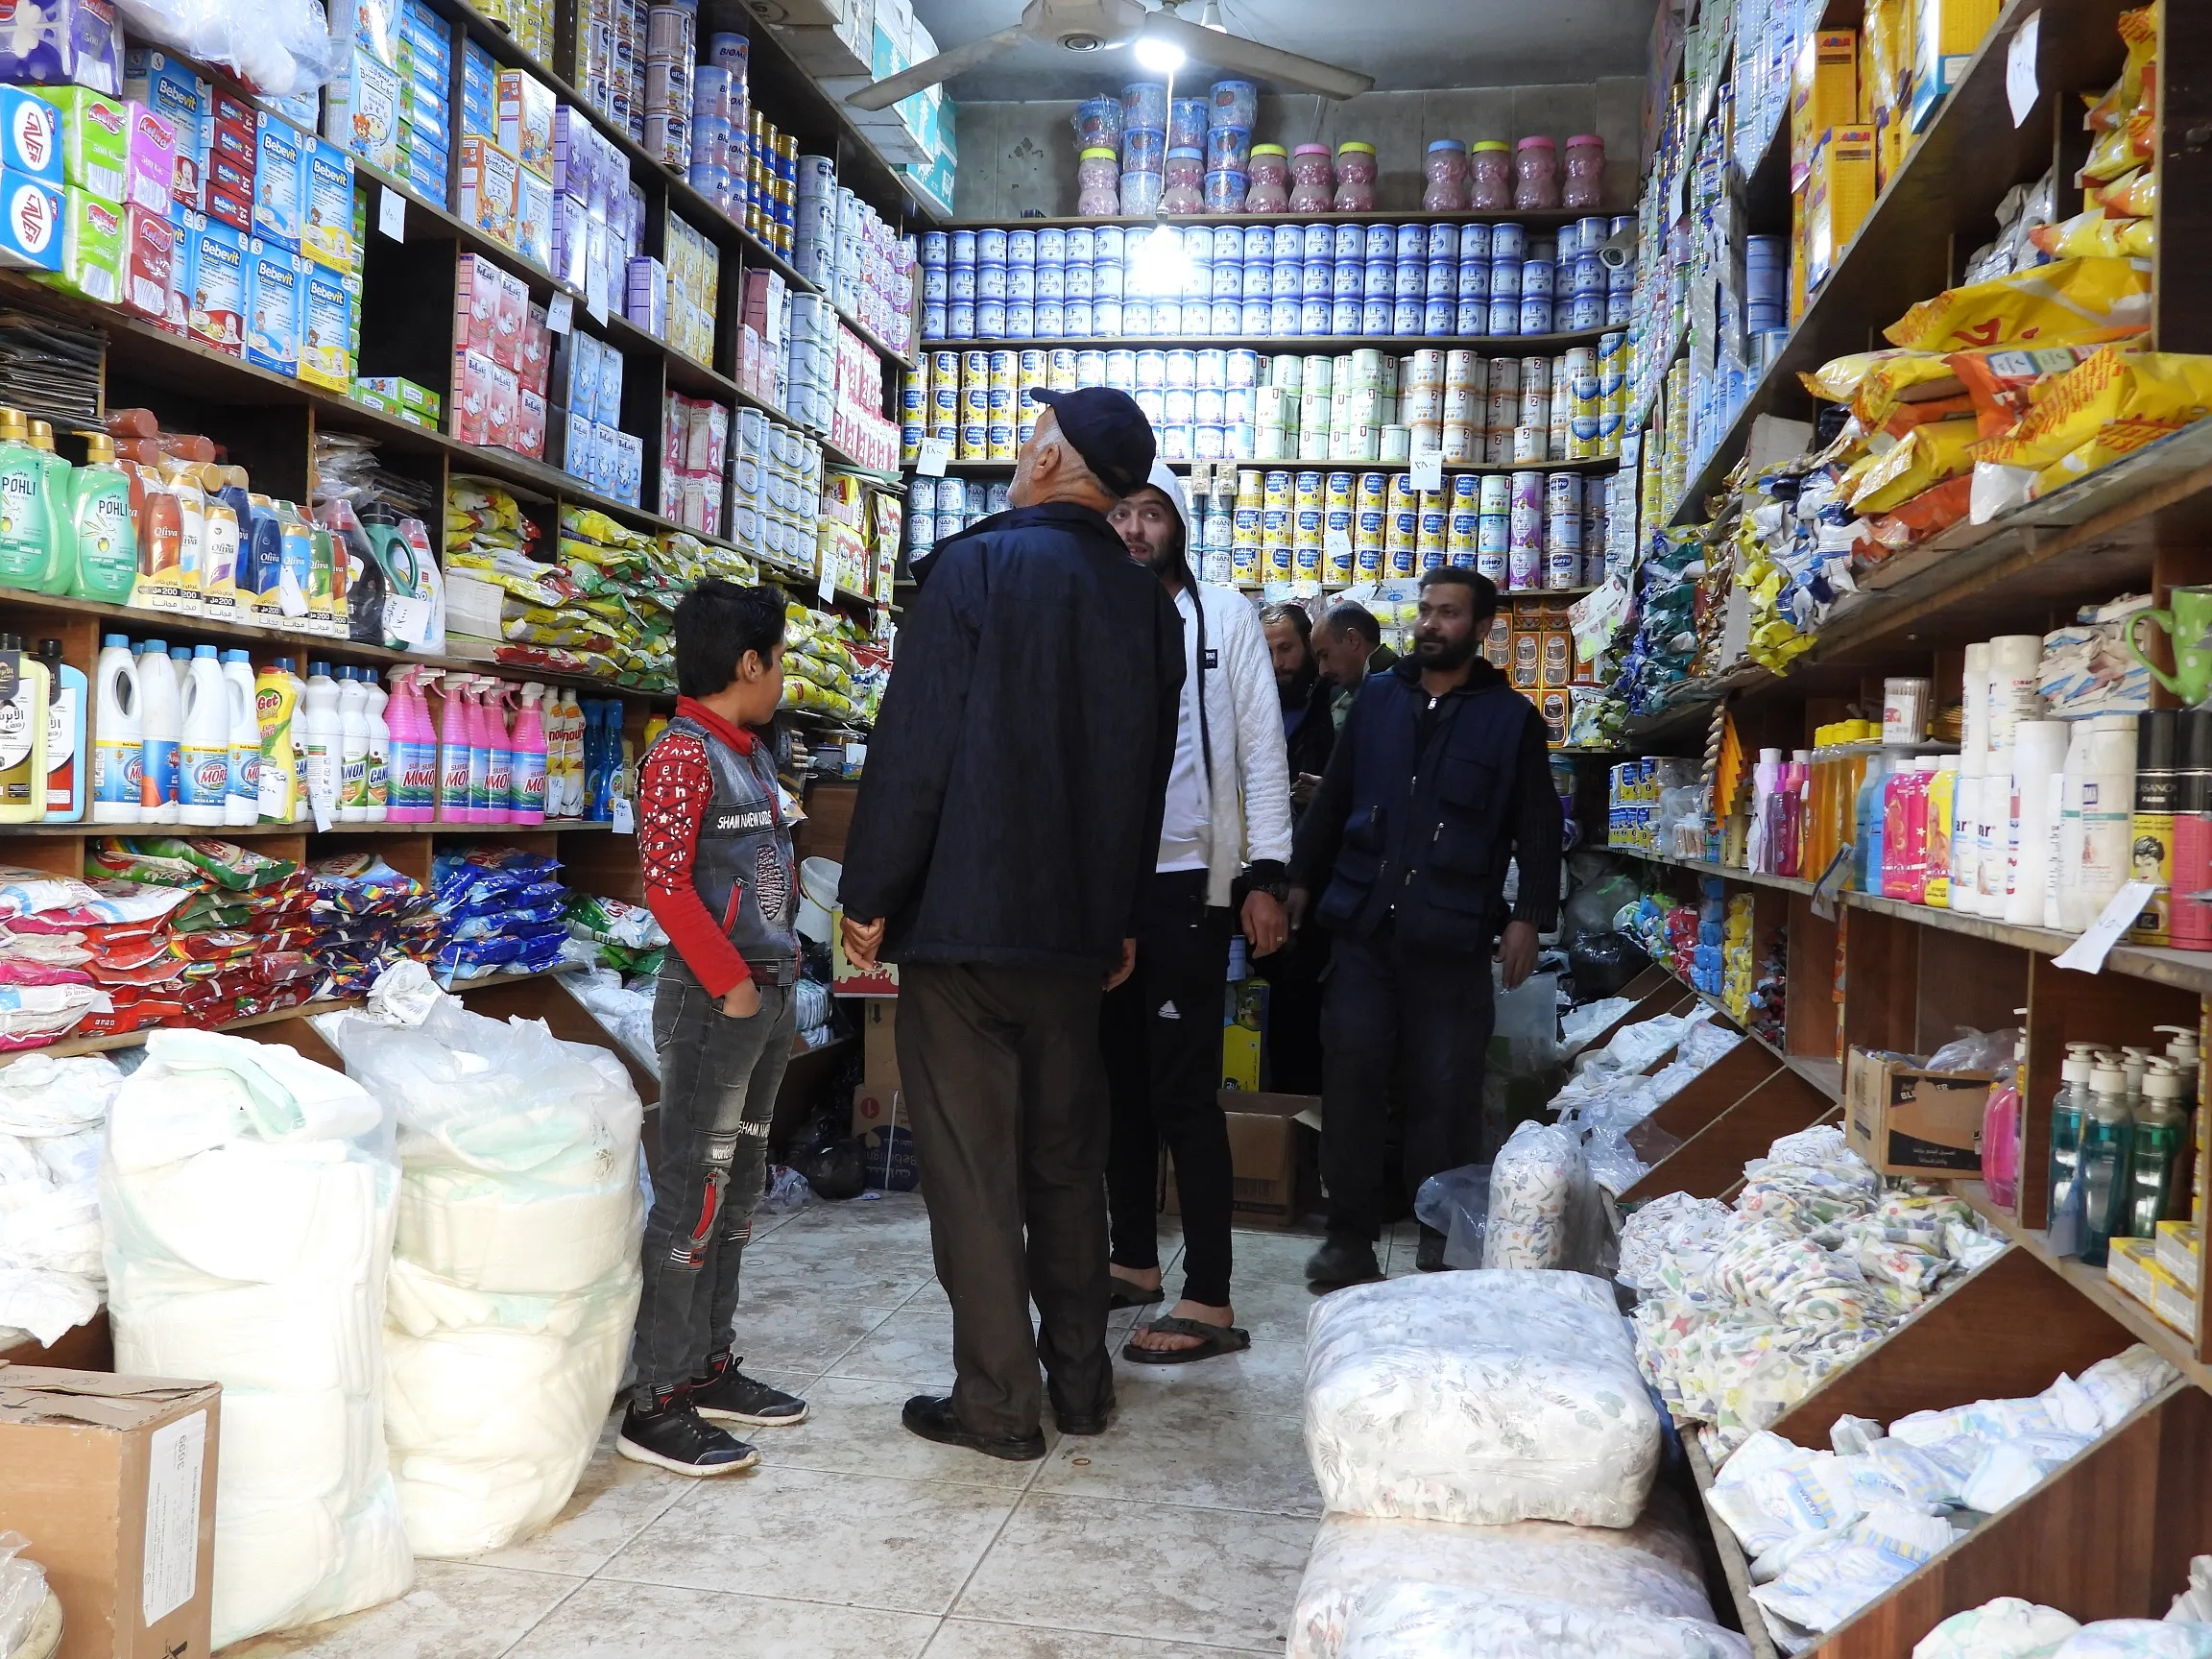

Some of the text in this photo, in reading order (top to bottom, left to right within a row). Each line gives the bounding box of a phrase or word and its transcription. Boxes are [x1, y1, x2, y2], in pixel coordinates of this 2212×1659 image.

[160, 80, 197, 110] Bebevit
[220, 101, 242, 119] Bebevit
[221, 133, 243, 151] Bebevit
[265, 135, 296, 162] Bebevit
[218, 165, 239, 183] Bebevit
[314, 160, 348, 187] Bebevit
[214, 197, 236, 213] Bebevit
[202, 239, 239, 266] Bebevit
[259, 262, 294, 286] Bebevit
[311, 282, 344, 304] Bebevit
[671, 438, 679, 458] 2
[2, 477, 36, 495] POHLI
[99, 500, 128, 517] POHLI
[155, 526, 178, 537] Oliva
[706, 517, 713, 535] 2
[212, 543, 234, 554] Oliva
[260, 553, 279, 563] Oliva
[284, 557, 304, 565] Oliva
[258, 694, 278, 709] Get
[717, 815, 740, 830] SHAM
[738, 1121, 759, 1136] SHAM
